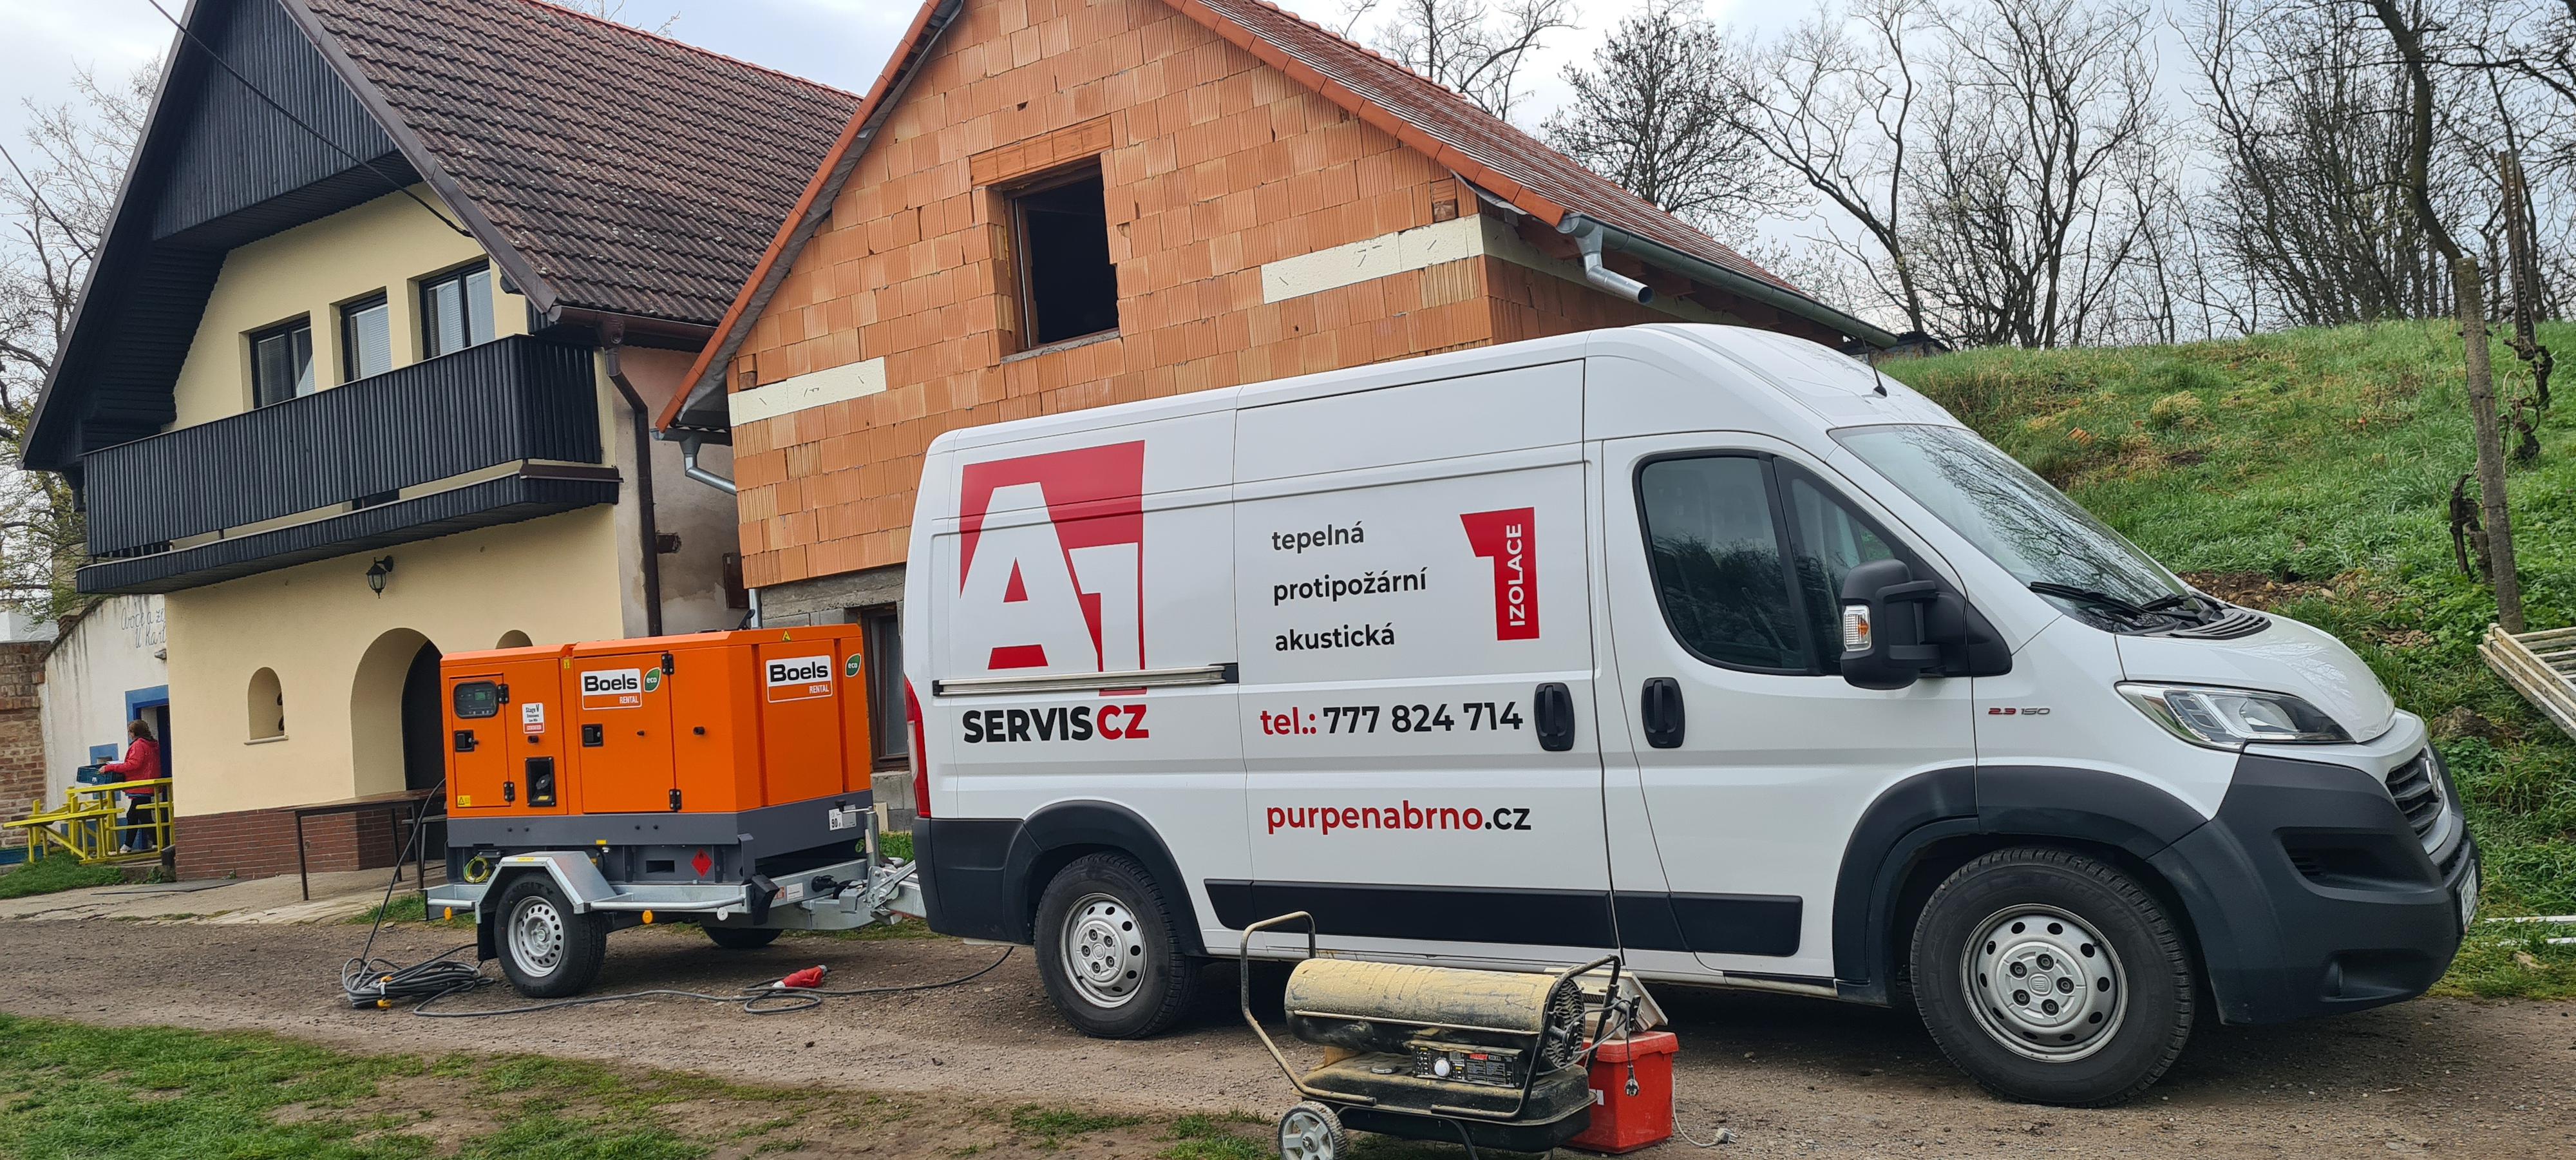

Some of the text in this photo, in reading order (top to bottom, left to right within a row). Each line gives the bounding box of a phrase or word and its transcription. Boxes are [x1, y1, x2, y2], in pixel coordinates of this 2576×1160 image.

[1271, 521, 1364, 554] tepelná
[1274, 567, 1428, 606] protipožární
[1506, 524, 1526, 627] IZOLACE
[1275, 622, 1395, 651] akustická
[584, 674, 638, 692] Boels
[770, 661, 828, 683] Boels
[619, 696, 639, 704] RENTAL
[809, 684, 829, 694] RENTAL
[1260, 701, 1524, 736] tel.: 777 824 714
[1267, 800, 1531, 835] purpenabrno.cz
